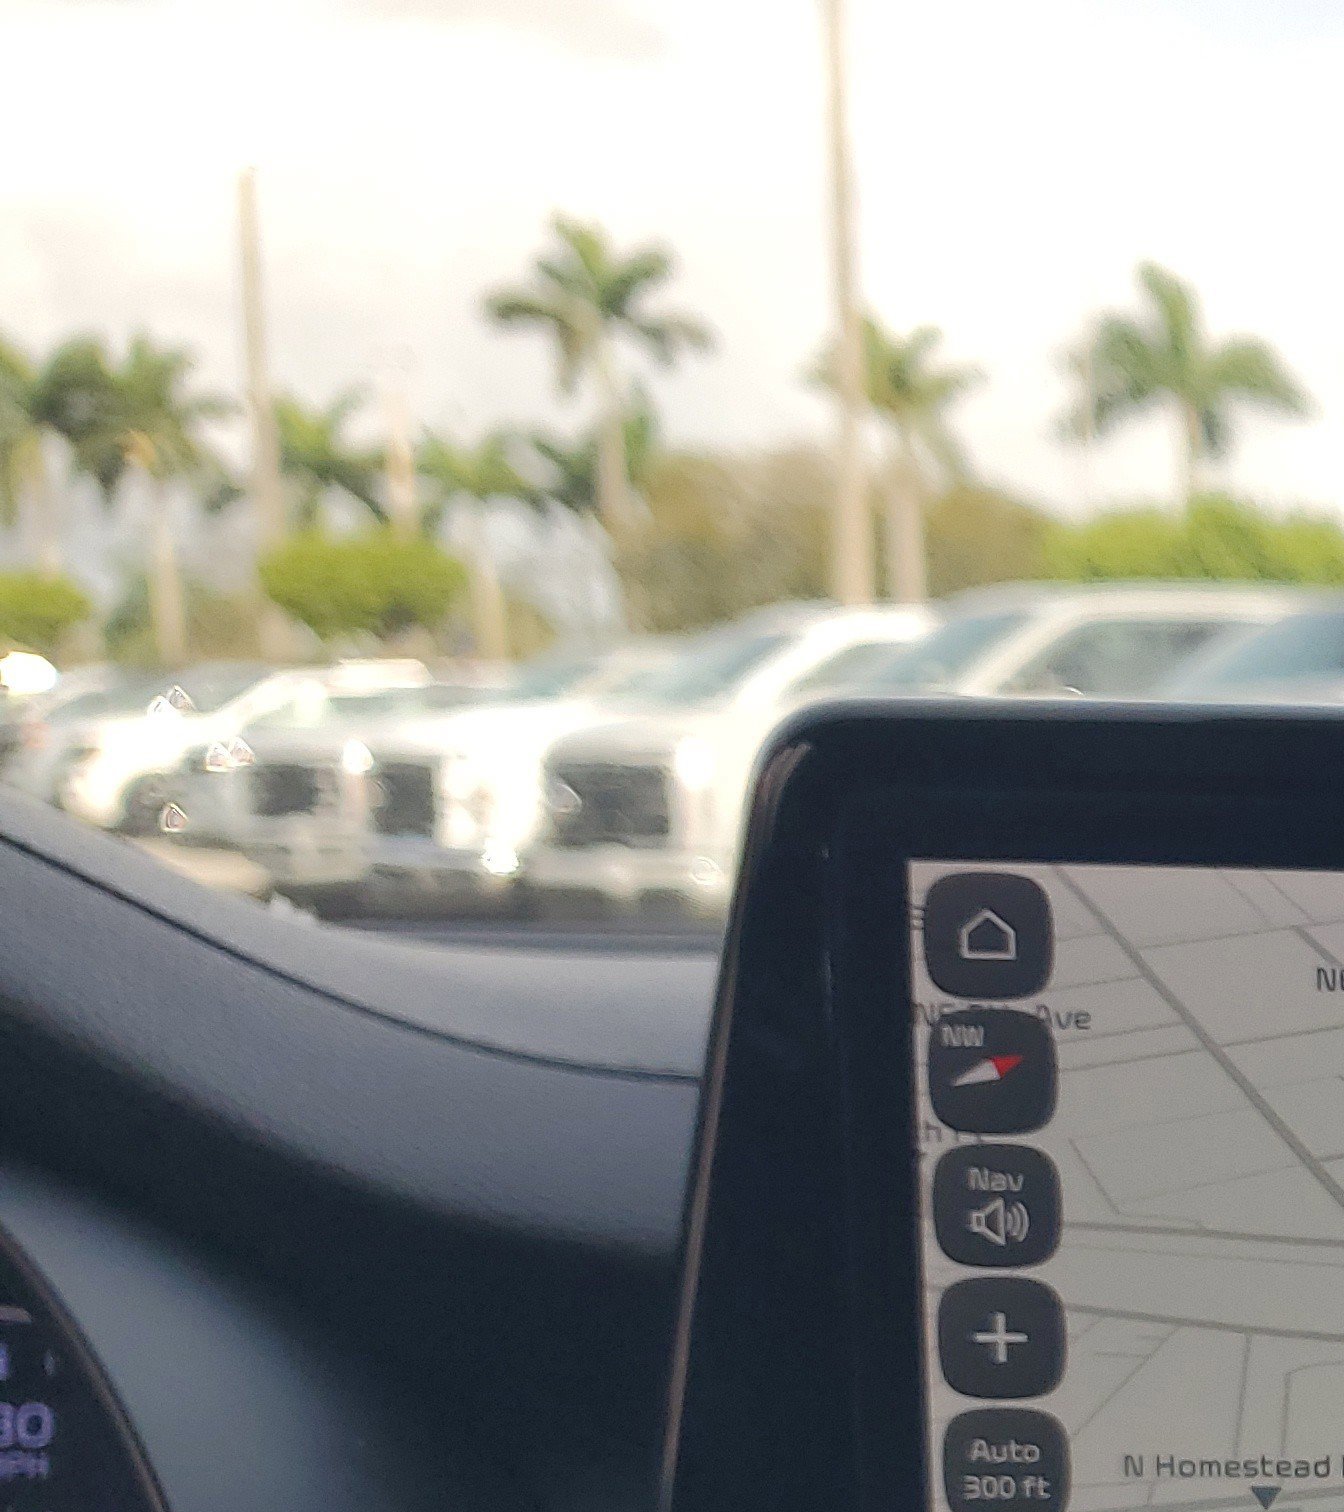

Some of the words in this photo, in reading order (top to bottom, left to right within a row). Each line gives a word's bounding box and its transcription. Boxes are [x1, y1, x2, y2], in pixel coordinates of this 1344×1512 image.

[968, 1167, 1024, 1191] Nav
[970, 1439, 1041, 1463] Auto
[1124, 1455, 1144, 1477] N
[1156, 1454, 1331, 1478] Homestead
[962, 1475, 1013, 1499] 300
[1020, 1473, 1051, 1498] ft
